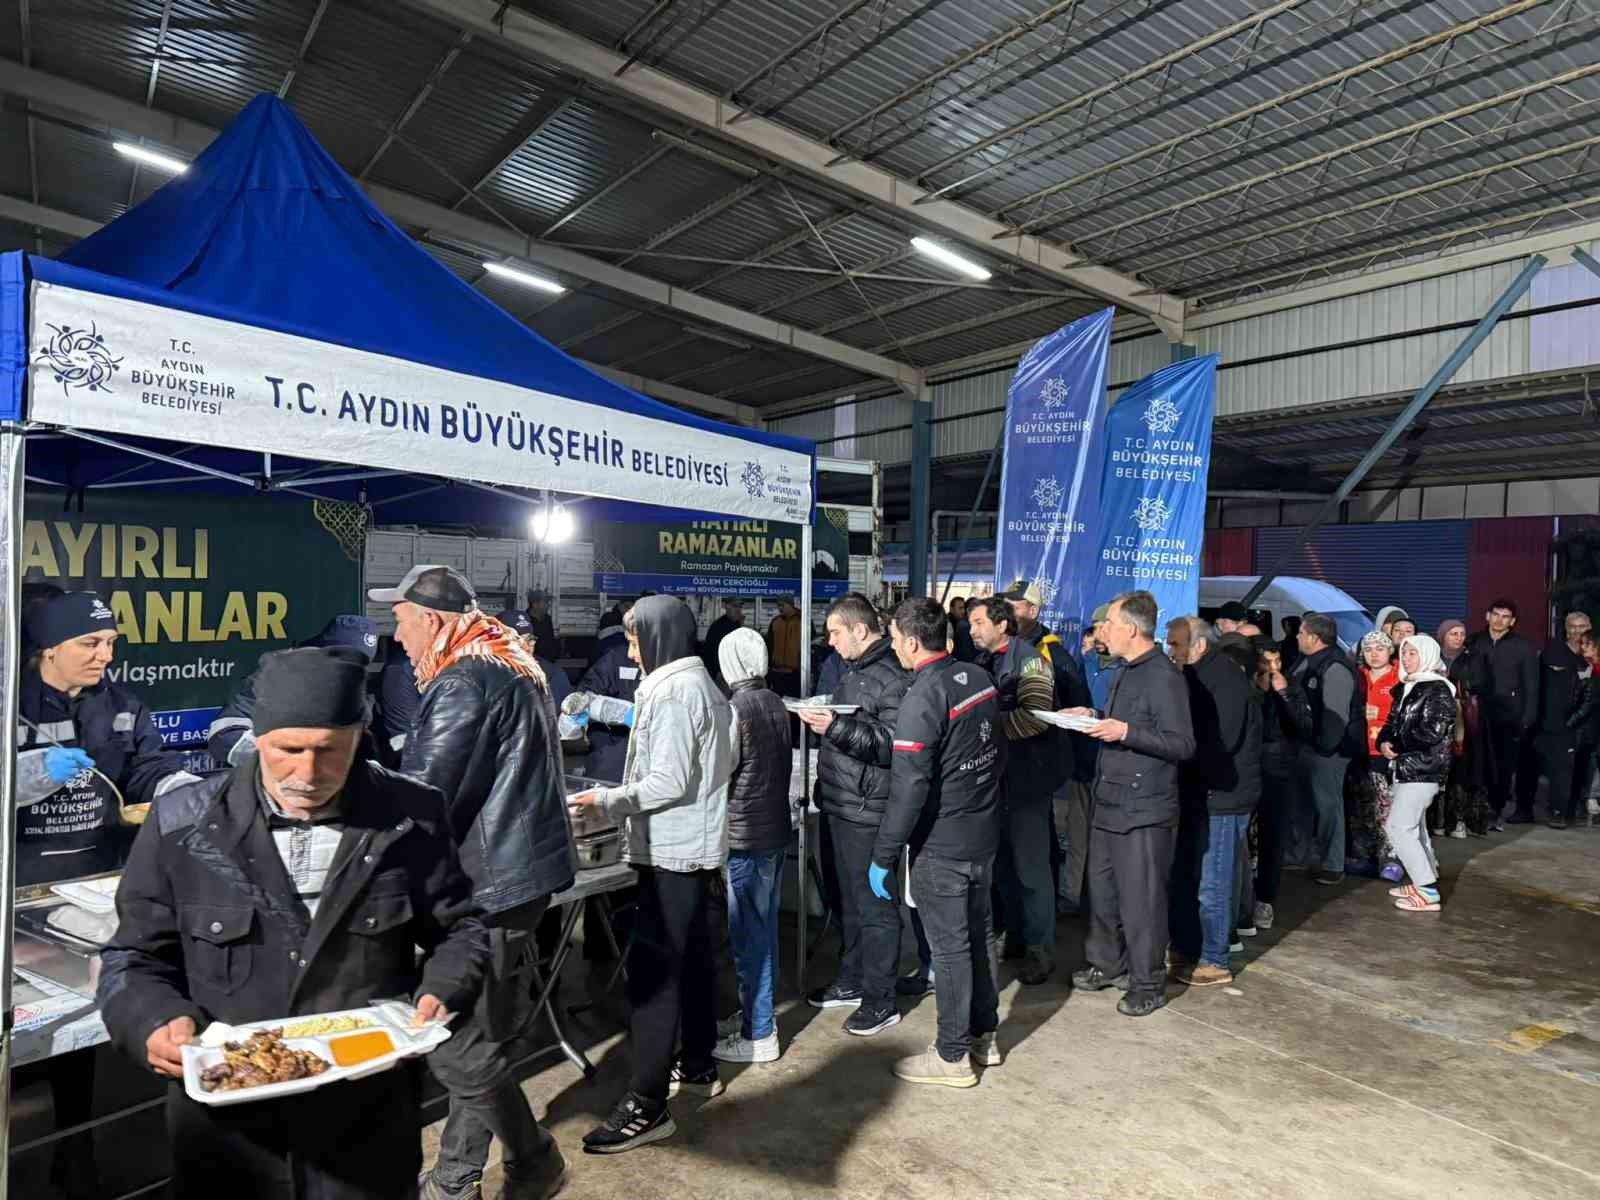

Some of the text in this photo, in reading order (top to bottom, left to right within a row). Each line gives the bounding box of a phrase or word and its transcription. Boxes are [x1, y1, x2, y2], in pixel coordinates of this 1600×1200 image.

[169, 338, 195, 354] T.C.
[161, 358, 205, 375] AYDIN
[131, 369, 235, 399] BÜYÜKŞEHİR
[142, 391, 222, 415] BELEDİYESİ
[1048, 411, 1075, 420] AYDIN
[265, 376, 729, 487] T.C. AYDIN BÜYÜKŞEHİR BELEDİYESİ
[1015, 419, 1091, 434] BÜYÜKŞEHİR
[1027, 433, 1076, 443] BELEDİYESİ
[1124, 437, 1194, 452] T.C. AYDIN
[1112, 449, 1202, 467] BÜYÜKŞEHİR
[1116, 467, 1196, 482] BELEDİYESİ
[22, 520, 208, 579] AYIRLI
[659, 532, 797, 559] RAMAZANLAR
[1114, 535, 1185, 550] T.C. AYDIN
[1102, 547, 1193, 567] BÜYÜKŞEHİR
[680, 560, 722, 571] Ramazan
[1106, 565, 1187, 580] BELEDİYESİ
[111, 591, 288, 643] ANLAR
